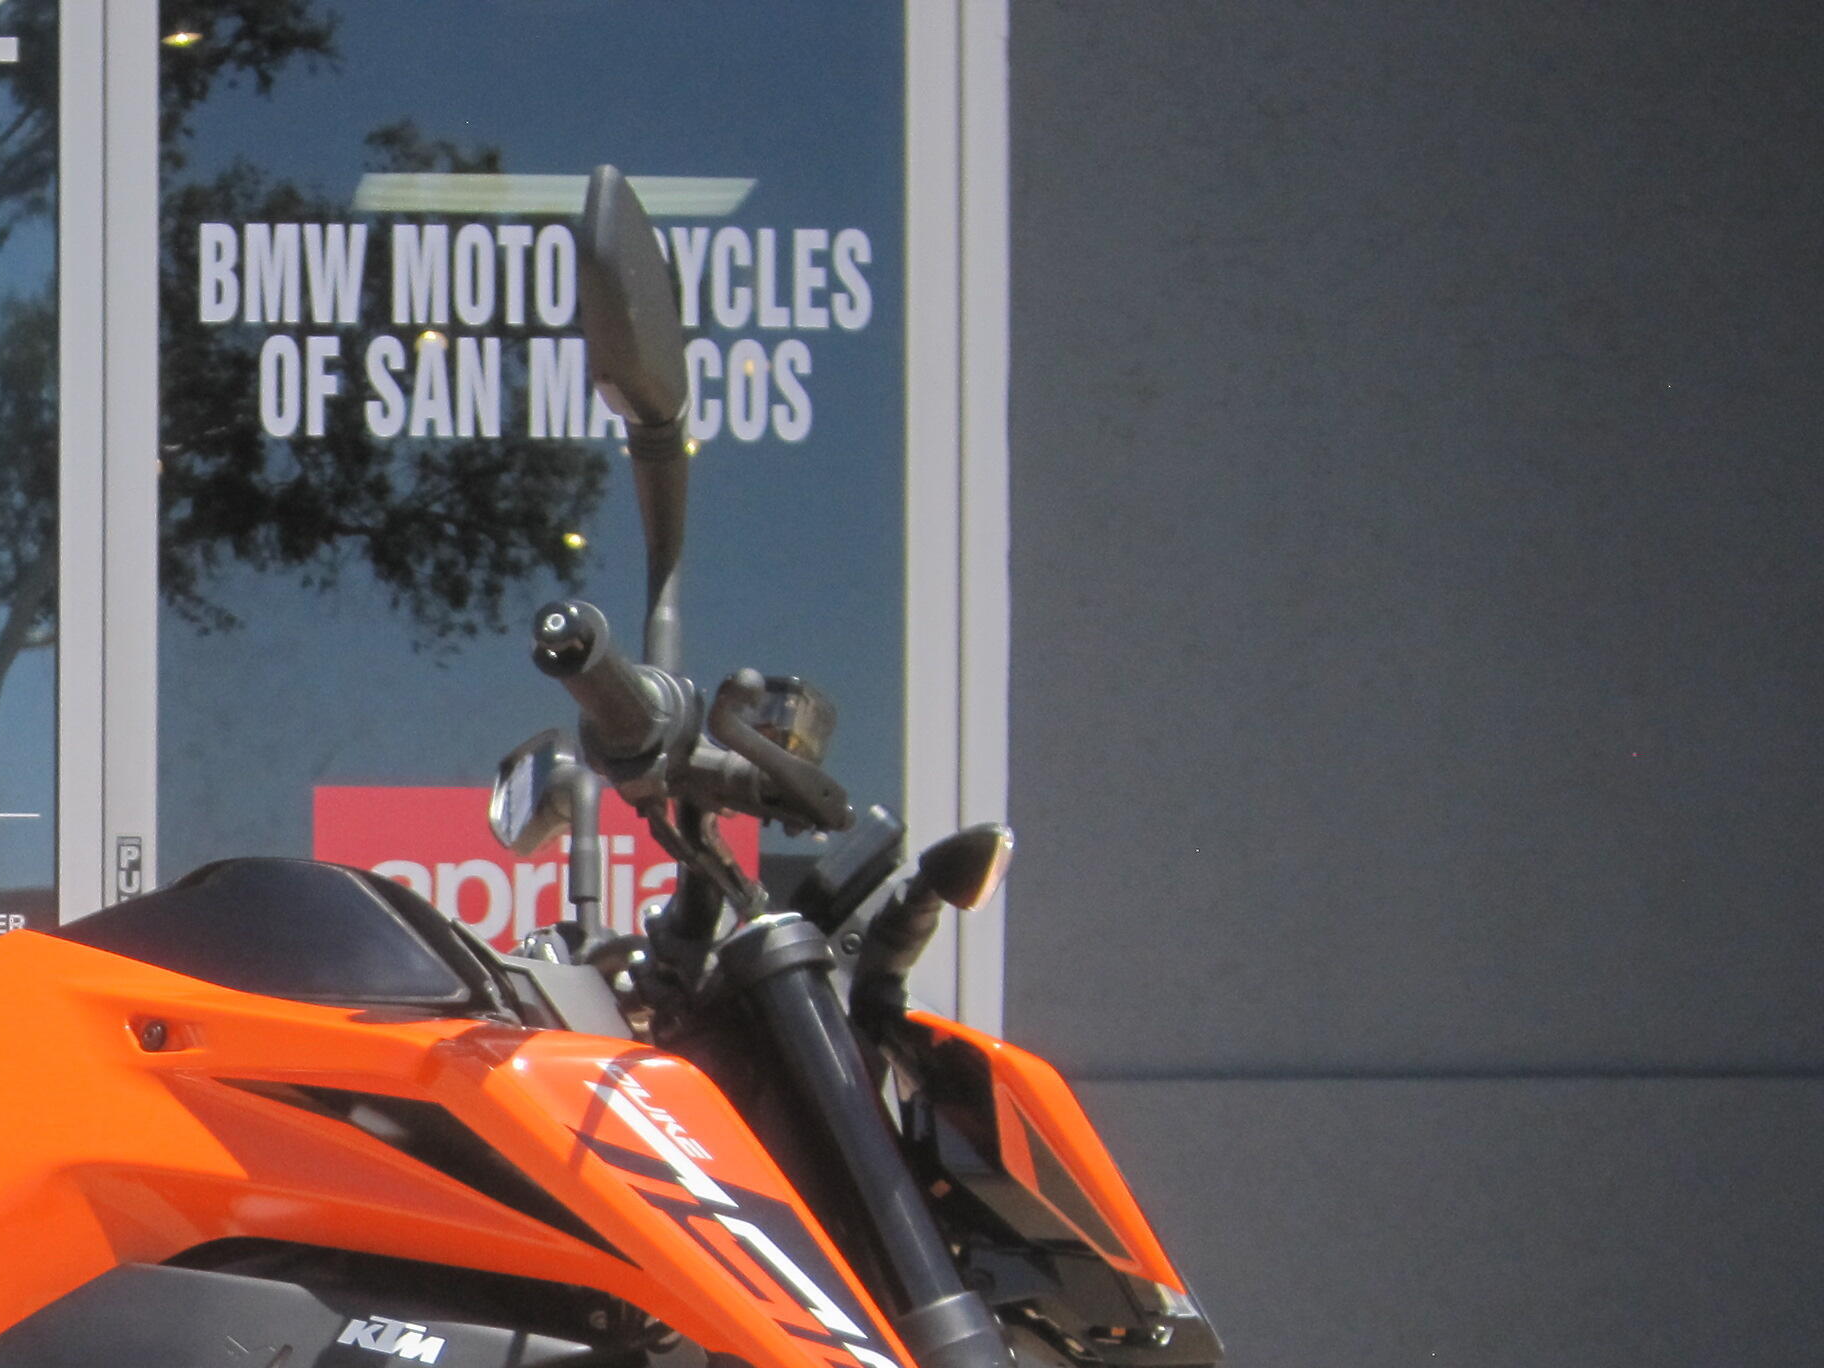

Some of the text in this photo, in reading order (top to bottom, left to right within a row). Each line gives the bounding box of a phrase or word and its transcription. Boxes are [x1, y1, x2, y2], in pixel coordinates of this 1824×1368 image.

[199, 223, 873, 330] BMW MOTOYCLES
[260, 335, 812, 442] OF SAN MCOS
[119, 845, 141, 901] PU
[595, 1061, 715, 1161] DUKE
[336, 1315, 447, 1365] KTM
